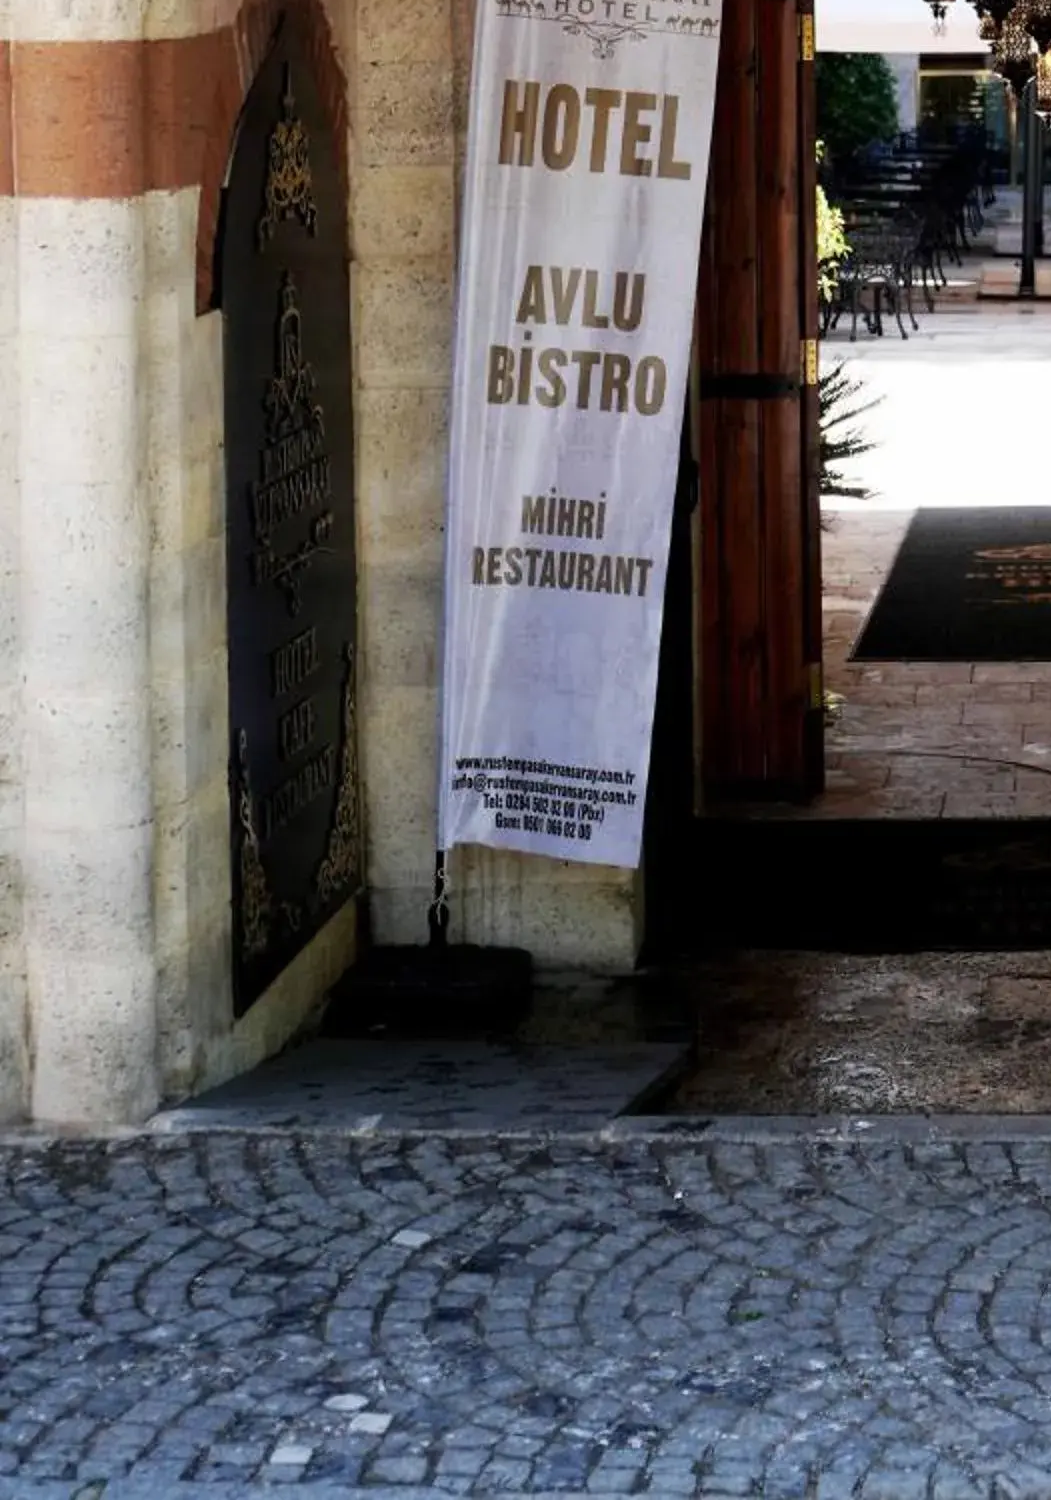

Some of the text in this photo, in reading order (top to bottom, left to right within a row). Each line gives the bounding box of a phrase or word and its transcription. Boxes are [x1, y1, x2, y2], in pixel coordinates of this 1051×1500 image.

[498, 80, 692, 180] HOTEL
[516, 265, 646, 333] AVLU
[487, 331, 669, 417] BİSTRO
[521, 487, 608, 541] MİHRİ
[471, 546, 653, 596] RESTAURANT
[272, 624, 322, 694] HOTEL
[280, 696, 319, 757] CAFE
[263, 742, 335, 840] RESTAURANT
[483, 793, 503, 809] Tel:
